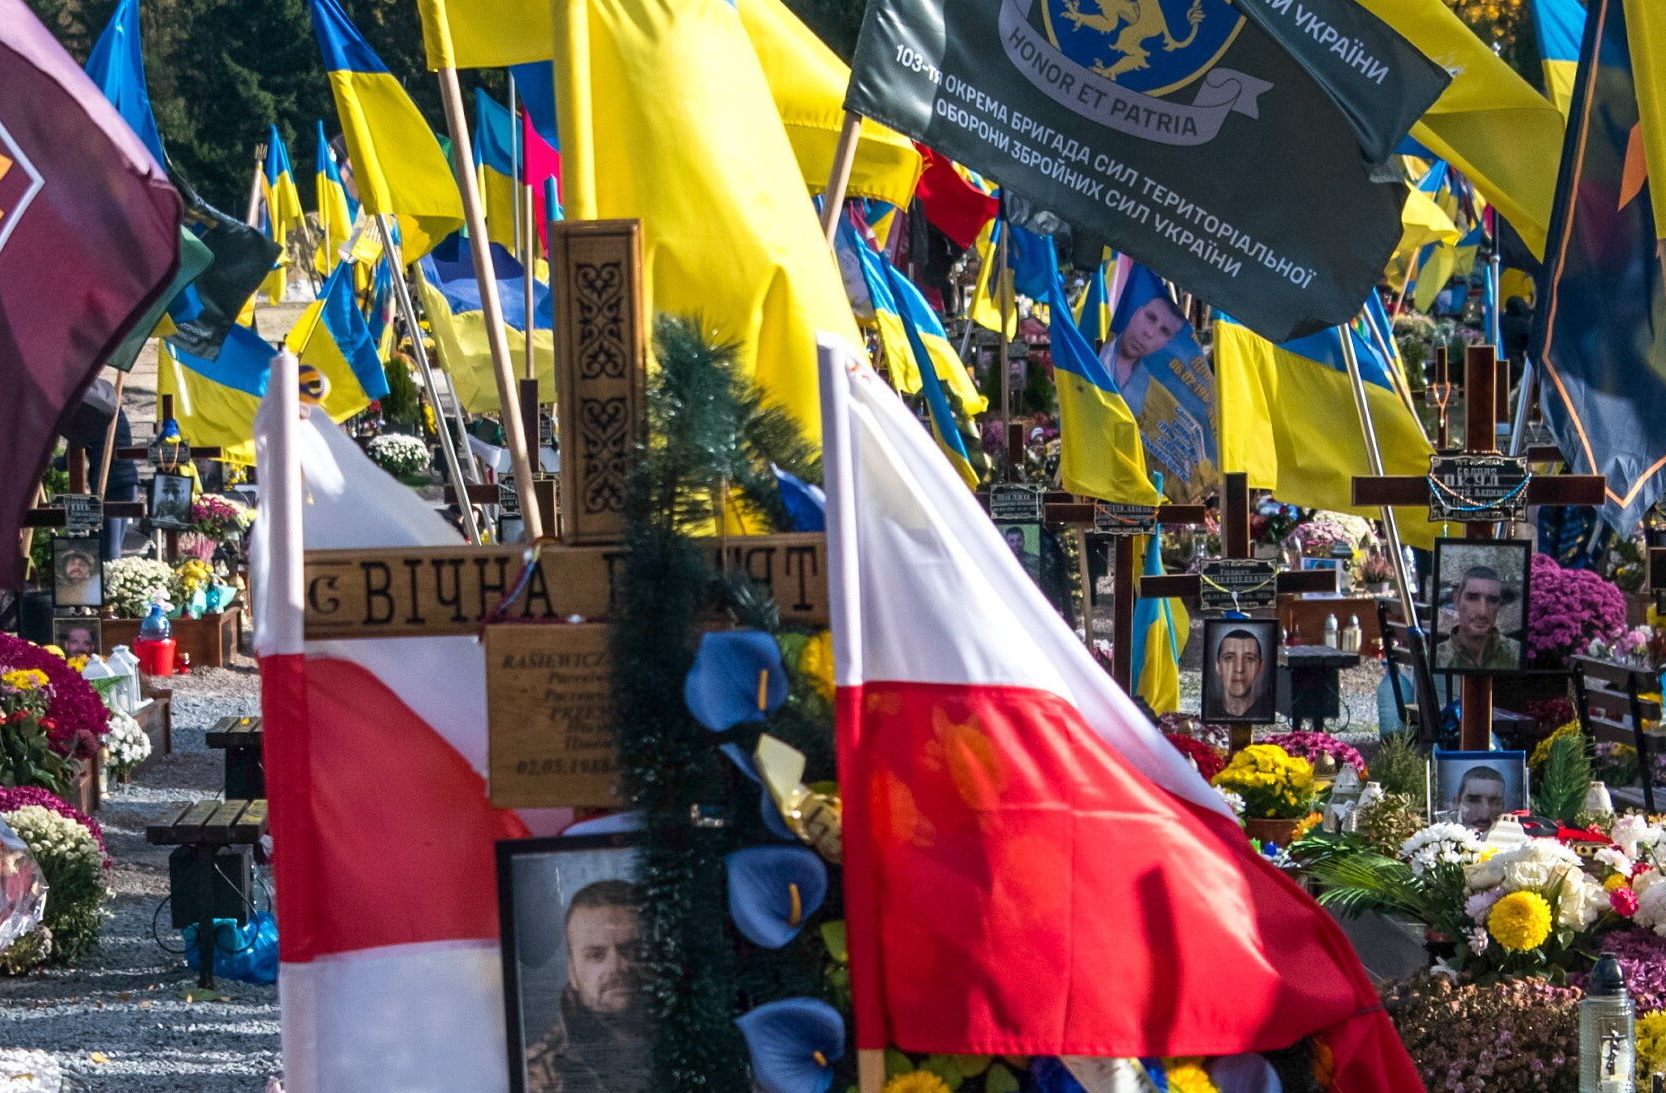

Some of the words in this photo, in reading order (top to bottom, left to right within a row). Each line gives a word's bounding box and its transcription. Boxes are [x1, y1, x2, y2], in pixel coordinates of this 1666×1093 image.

[1009, 28, 1075, 103] HONOR
[1078, 76, 1108, 112] ET
[1111, 98, 1199, 138] PATRIA
[1295, 2, 1390, 86] УКРАЇНИ
[936, 97, 1011, 156] ОБОРОНИ
[1011, 139, 1102, 203] ЗБРОЙНИХ
[1104, 190, 1148, 227] СИЛ
[1153, 213, 1243, 279] УКРАЇНИ
[945, 74, 1008, 125] ОКРЕМА
[1011, 110, 1091, 163] БРИГАДА
[1093, 154, 1139, 188] СИЛ
[1141, 176, 1317, 290] ТЕРИТОРІАЛЬНОЇ
[359, 555, 560, 626] ВІЧНА
